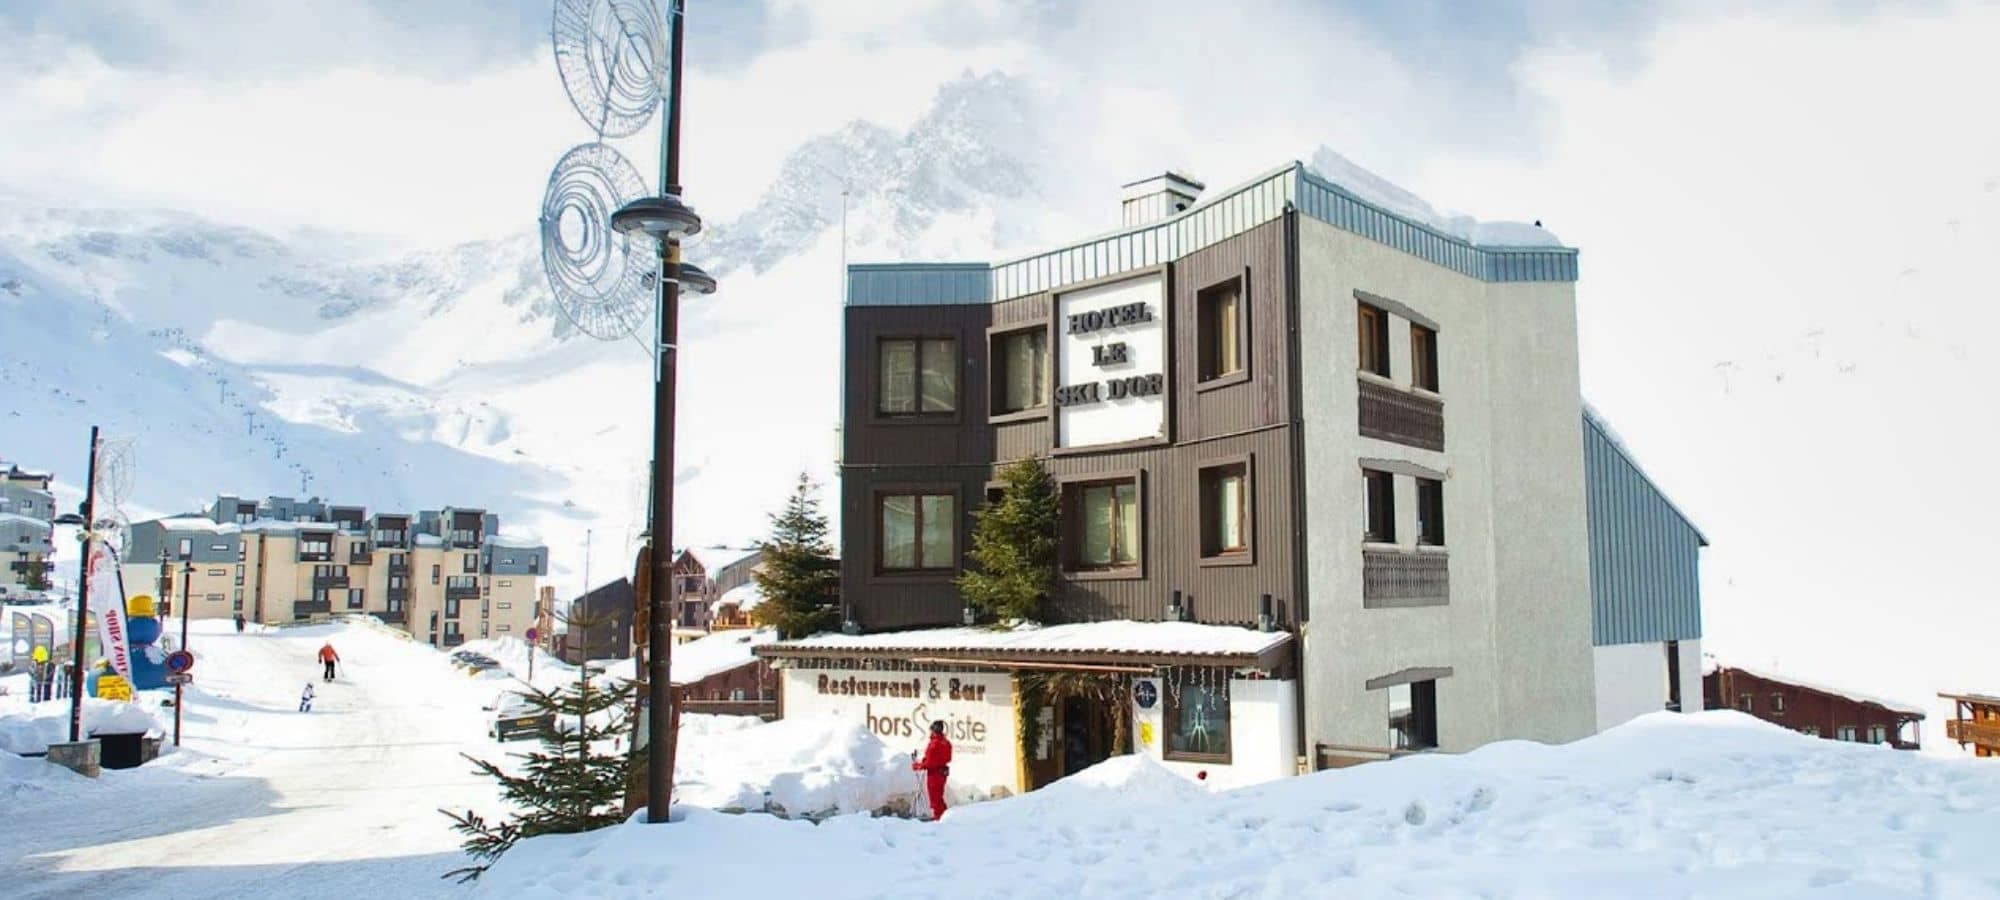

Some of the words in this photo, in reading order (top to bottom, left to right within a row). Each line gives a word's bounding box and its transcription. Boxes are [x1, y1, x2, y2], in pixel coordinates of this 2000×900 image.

[1067, 302, 1152, 335] HOTEL
[1092, 342, 1128, 366] LE
[1055, 381, 1101, 407] SKI
[1106, 373, 1163, 400] D'OR
[818, 674, 921, 698] Restaurant
[928, 677, 941, 699] &
[949, 678, 986, 701] Bar
[866, 703, 912, 737] hors
